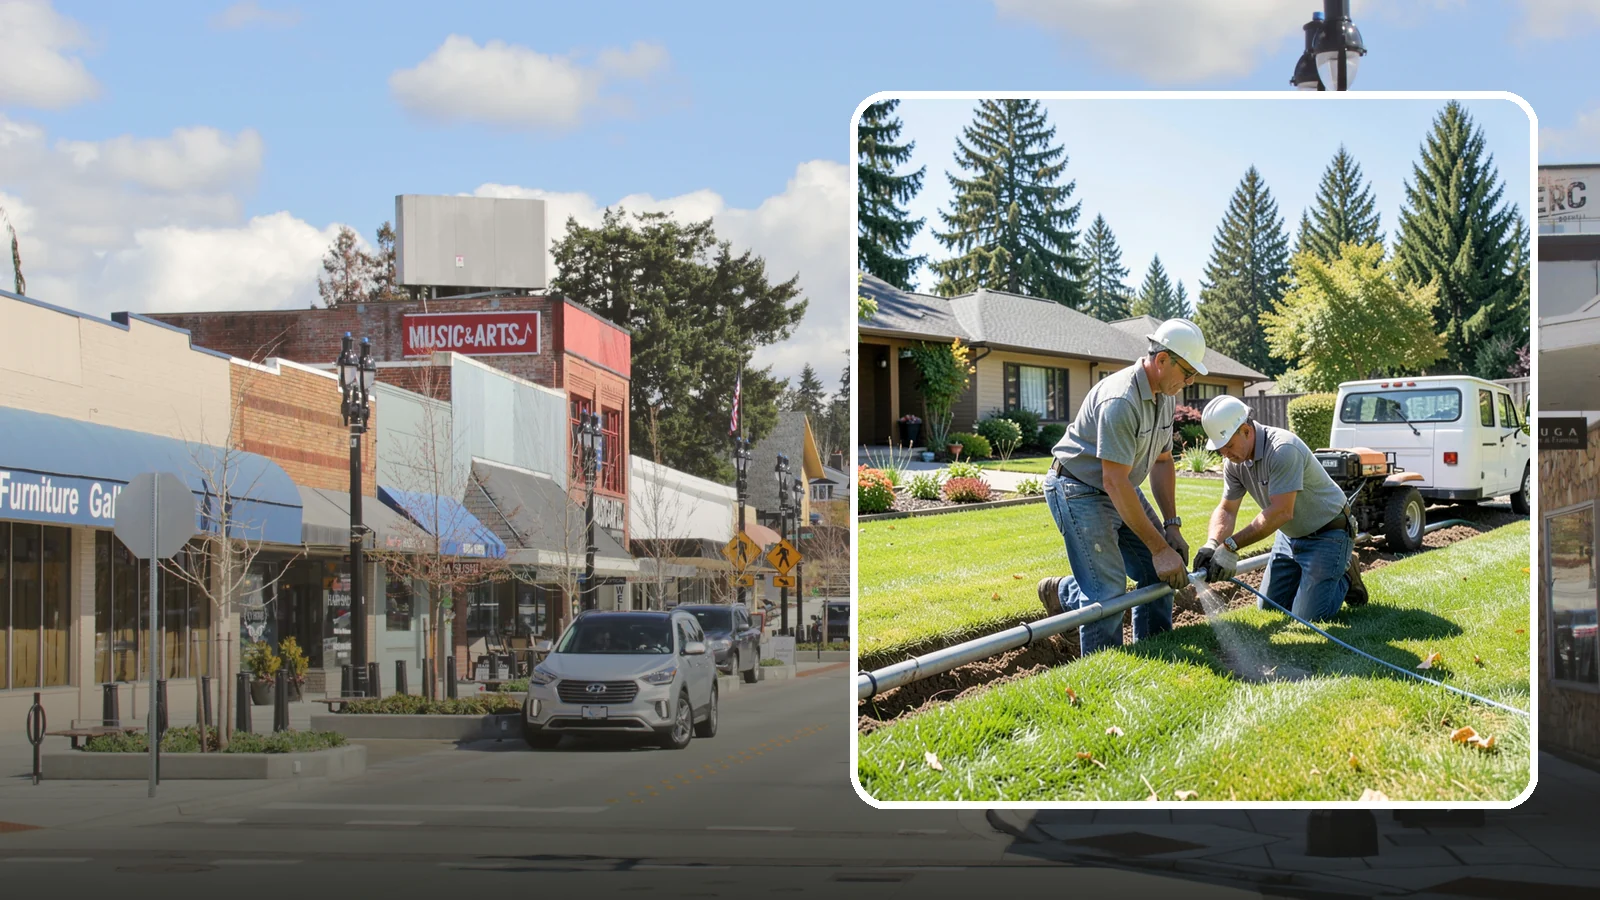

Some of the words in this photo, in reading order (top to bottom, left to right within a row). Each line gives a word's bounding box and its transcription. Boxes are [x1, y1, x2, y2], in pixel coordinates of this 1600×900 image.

[408, 322, 520, 349] MUSIC&ARTS
[1540, 427, 1577, 437] UGA
[0, 471, 79, 515] Furniture
[89, 482, 122, 520] Gal
